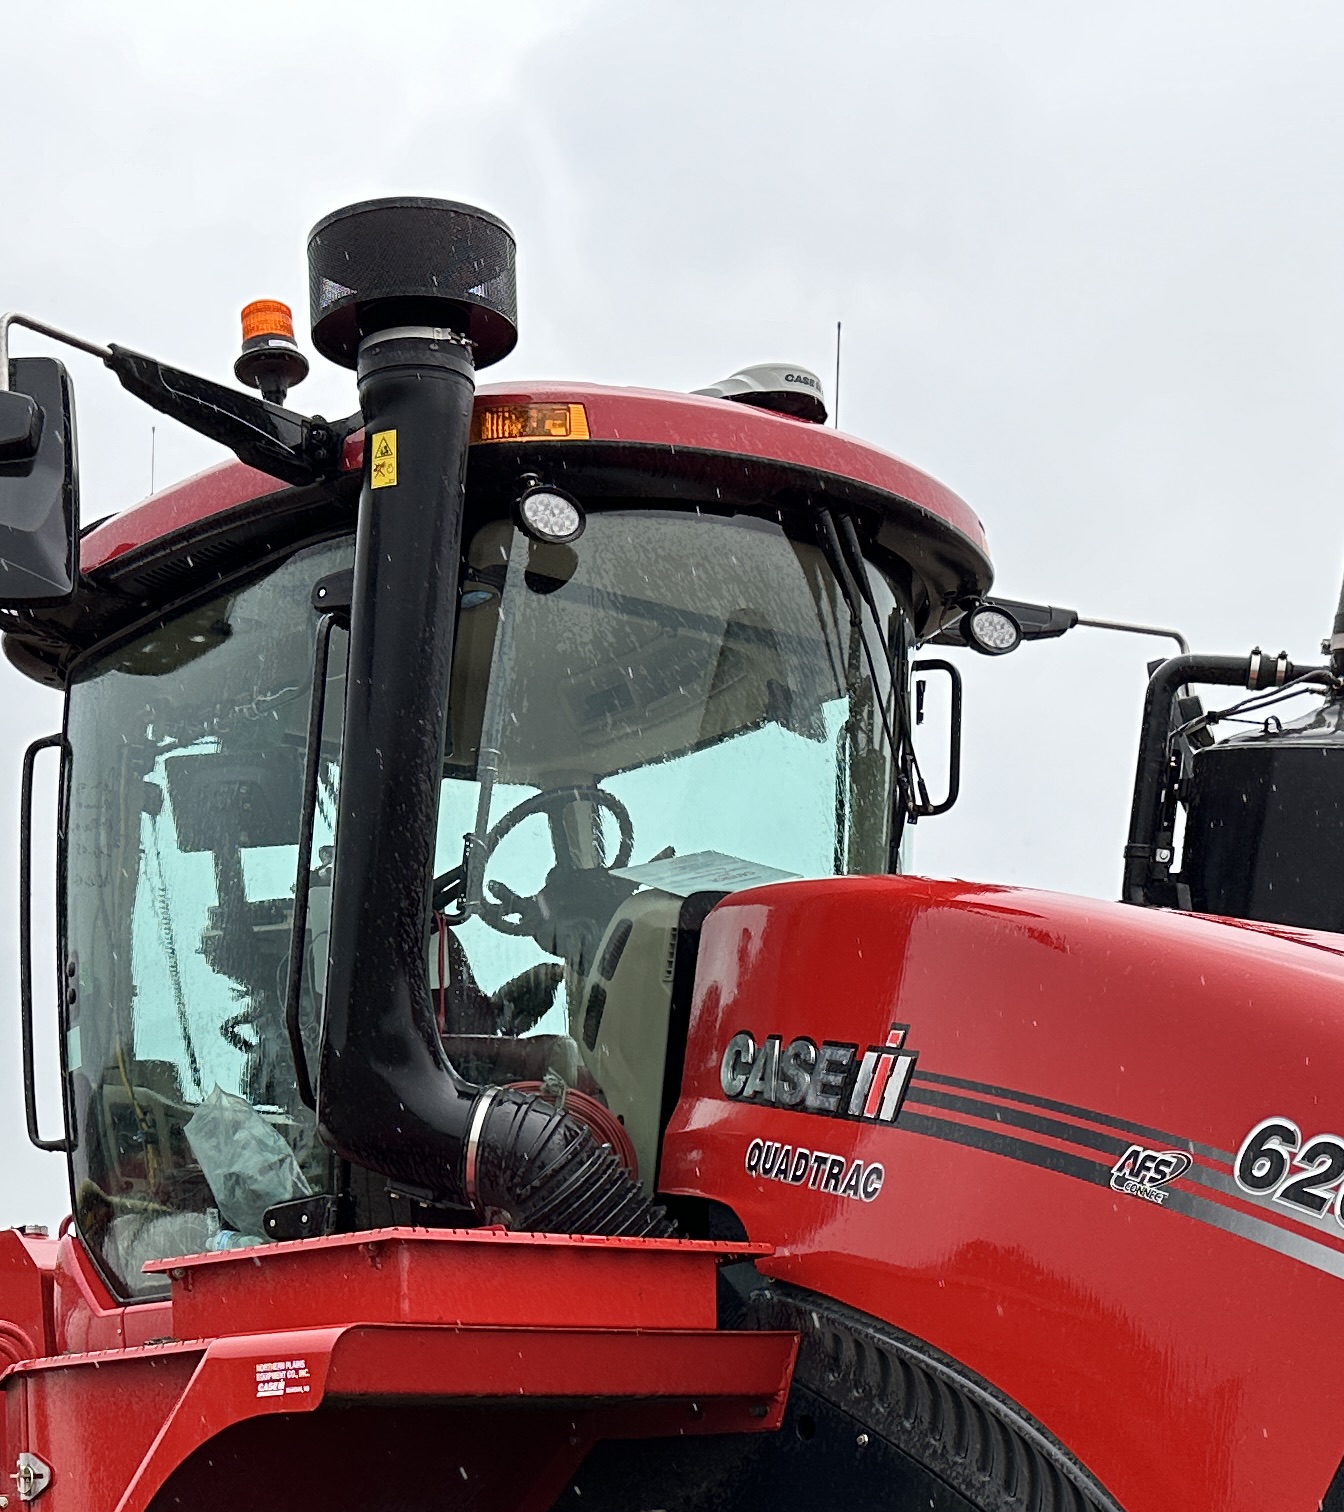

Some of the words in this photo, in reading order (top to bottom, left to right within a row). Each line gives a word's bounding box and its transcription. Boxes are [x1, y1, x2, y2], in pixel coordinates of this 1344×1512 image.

[785, 374, 815, 387] CASE
[721, 1031, 857, 1113] CASE
[746, 1138, 885, 1202] QUADTRAC
[1112, 1145, 1178, 1184] AFS
[1123, 1181, 1169, 1204] CONNECT
